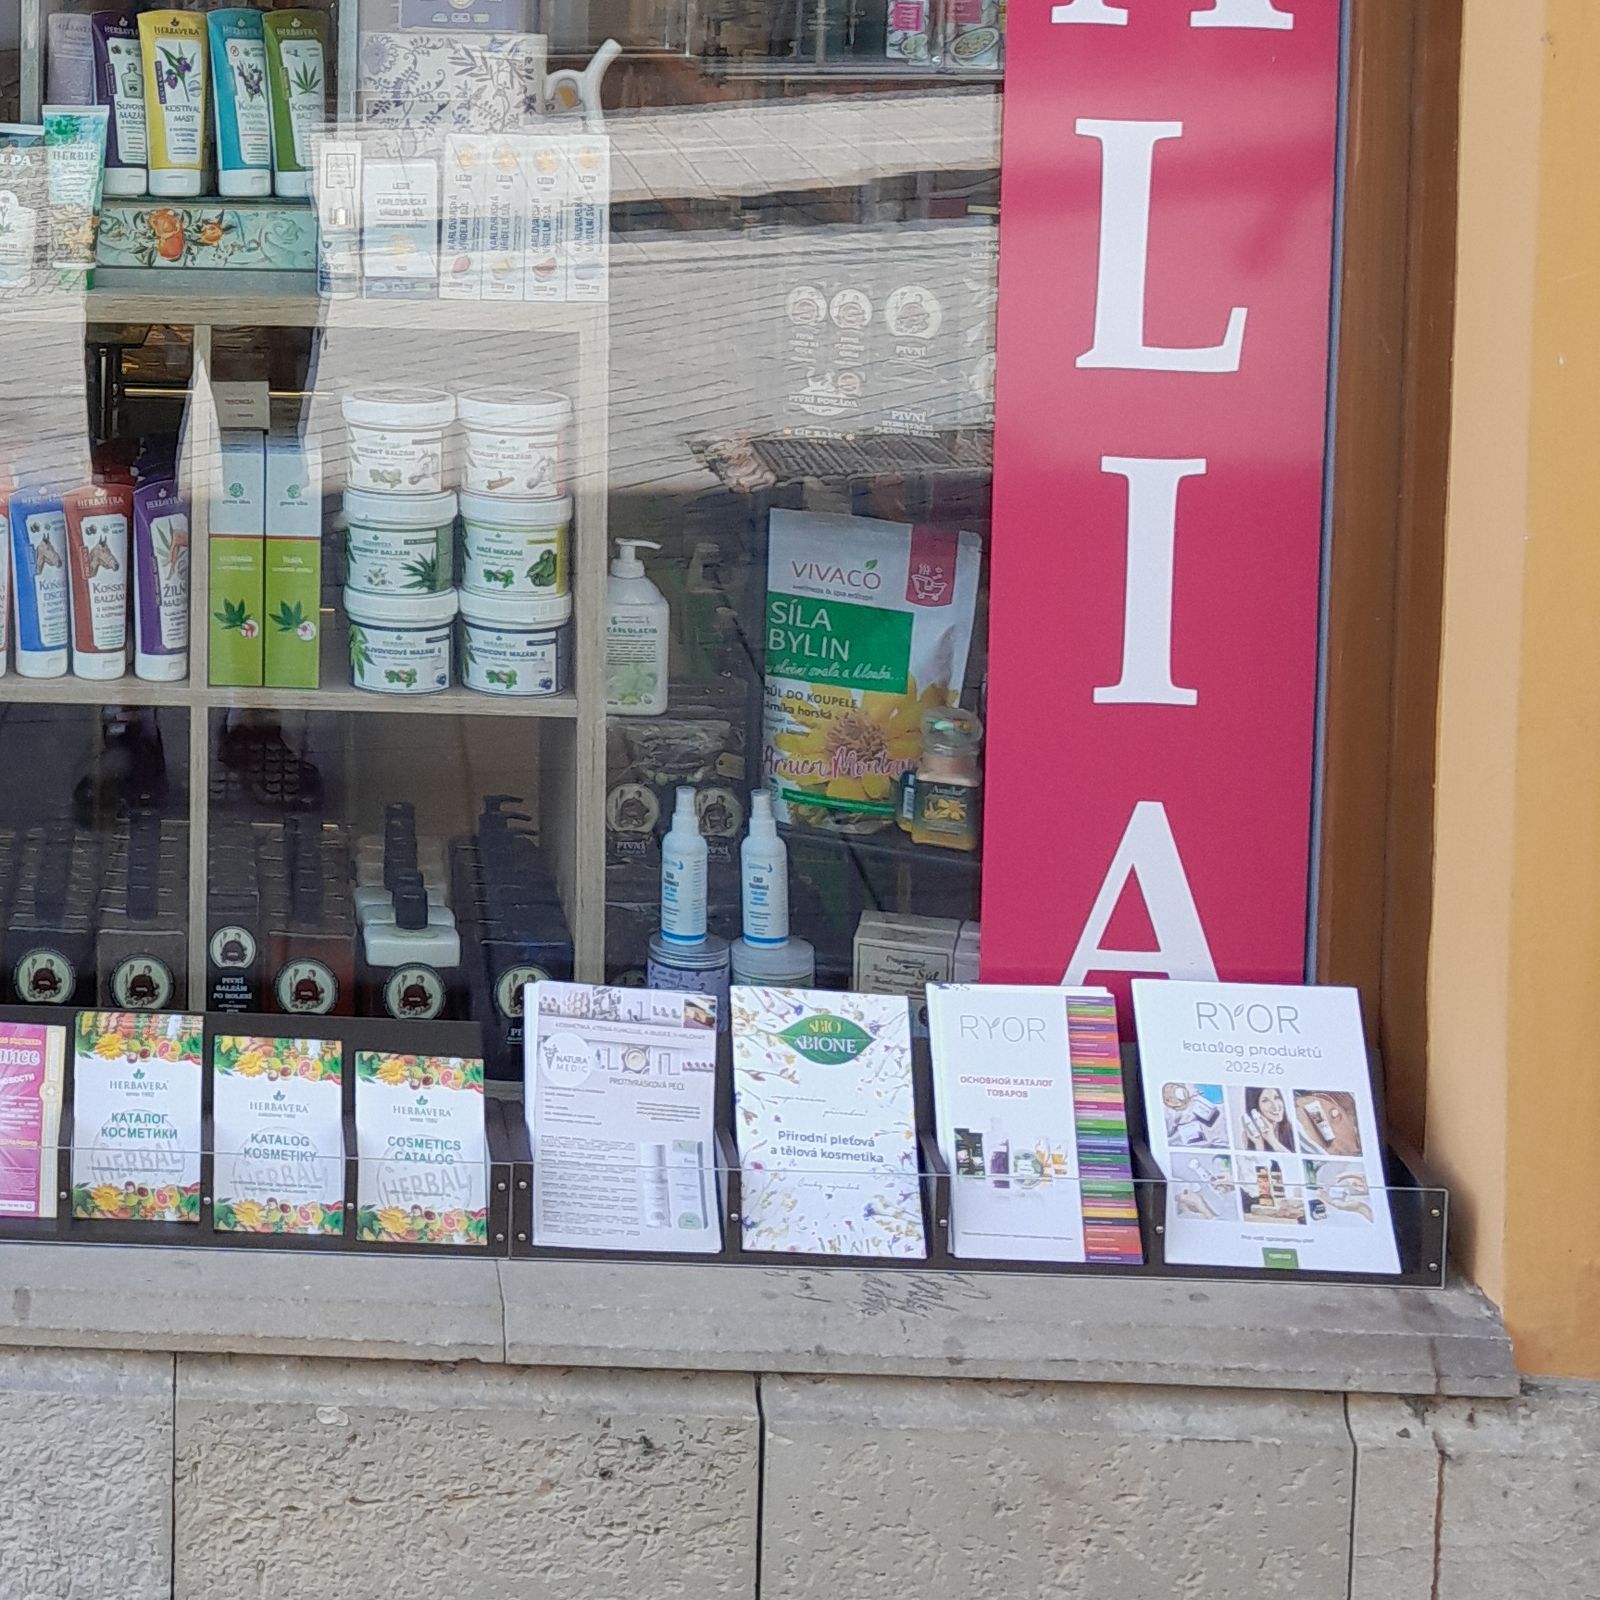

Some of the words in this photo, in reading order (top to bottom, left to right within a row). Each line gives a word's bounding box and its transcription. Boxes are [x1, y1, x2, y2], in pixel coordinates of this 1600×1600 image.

[791, 560, 881, 590] VIVACO
[769, 598, 833, 631] SÍLA
[768, 630, 851, 661] BYLIN
[787, 688, 802, 700] DO
[797, 705, 832, 720] horská
[1195, 1001, 1301, 1035] RYOR
[959, 1014, 1047, 1043] RYOR
[1182, 1040, 1245, 1057] katalog
[1248, 1042, 1323, 1059] produktů
[1224, 1059, 1285, 1076] 2025/26
[109, 1080, 168, 1091] HERBAVERA
[960, 1075, 1011, 1086] ОСНОВНОЙ
[1013, 1077, 1053, 1088] КАТАЛОГ
[986, 1088, 1029, 1099] ТОВАРОВ
[249, 1102, 309, 1114] HERBAVERA
[393, 1105, 451, 1118] HERBAVERA
[111, 1112, 169, 1125] КАТАЛОГ
[101, 1127, 178, 1140] КОСМЕТИКИ
[250, 1133, 310, 1147] KATALOG
[778, 1128, 828, 1144] Přírodní
[830, 1132, 876, 1148] pleťová
[387, 1136, 462, 1151] COSMETICS
[243, 1148, 317, 1163] KOSMETIKY
[394, 1152, 455, 1166] CATALOG
[770, 1147, 778, 1155] a
[779, 1144, 818, 1158] tělová
[820, 1147, 885, 1164] kosmetika
